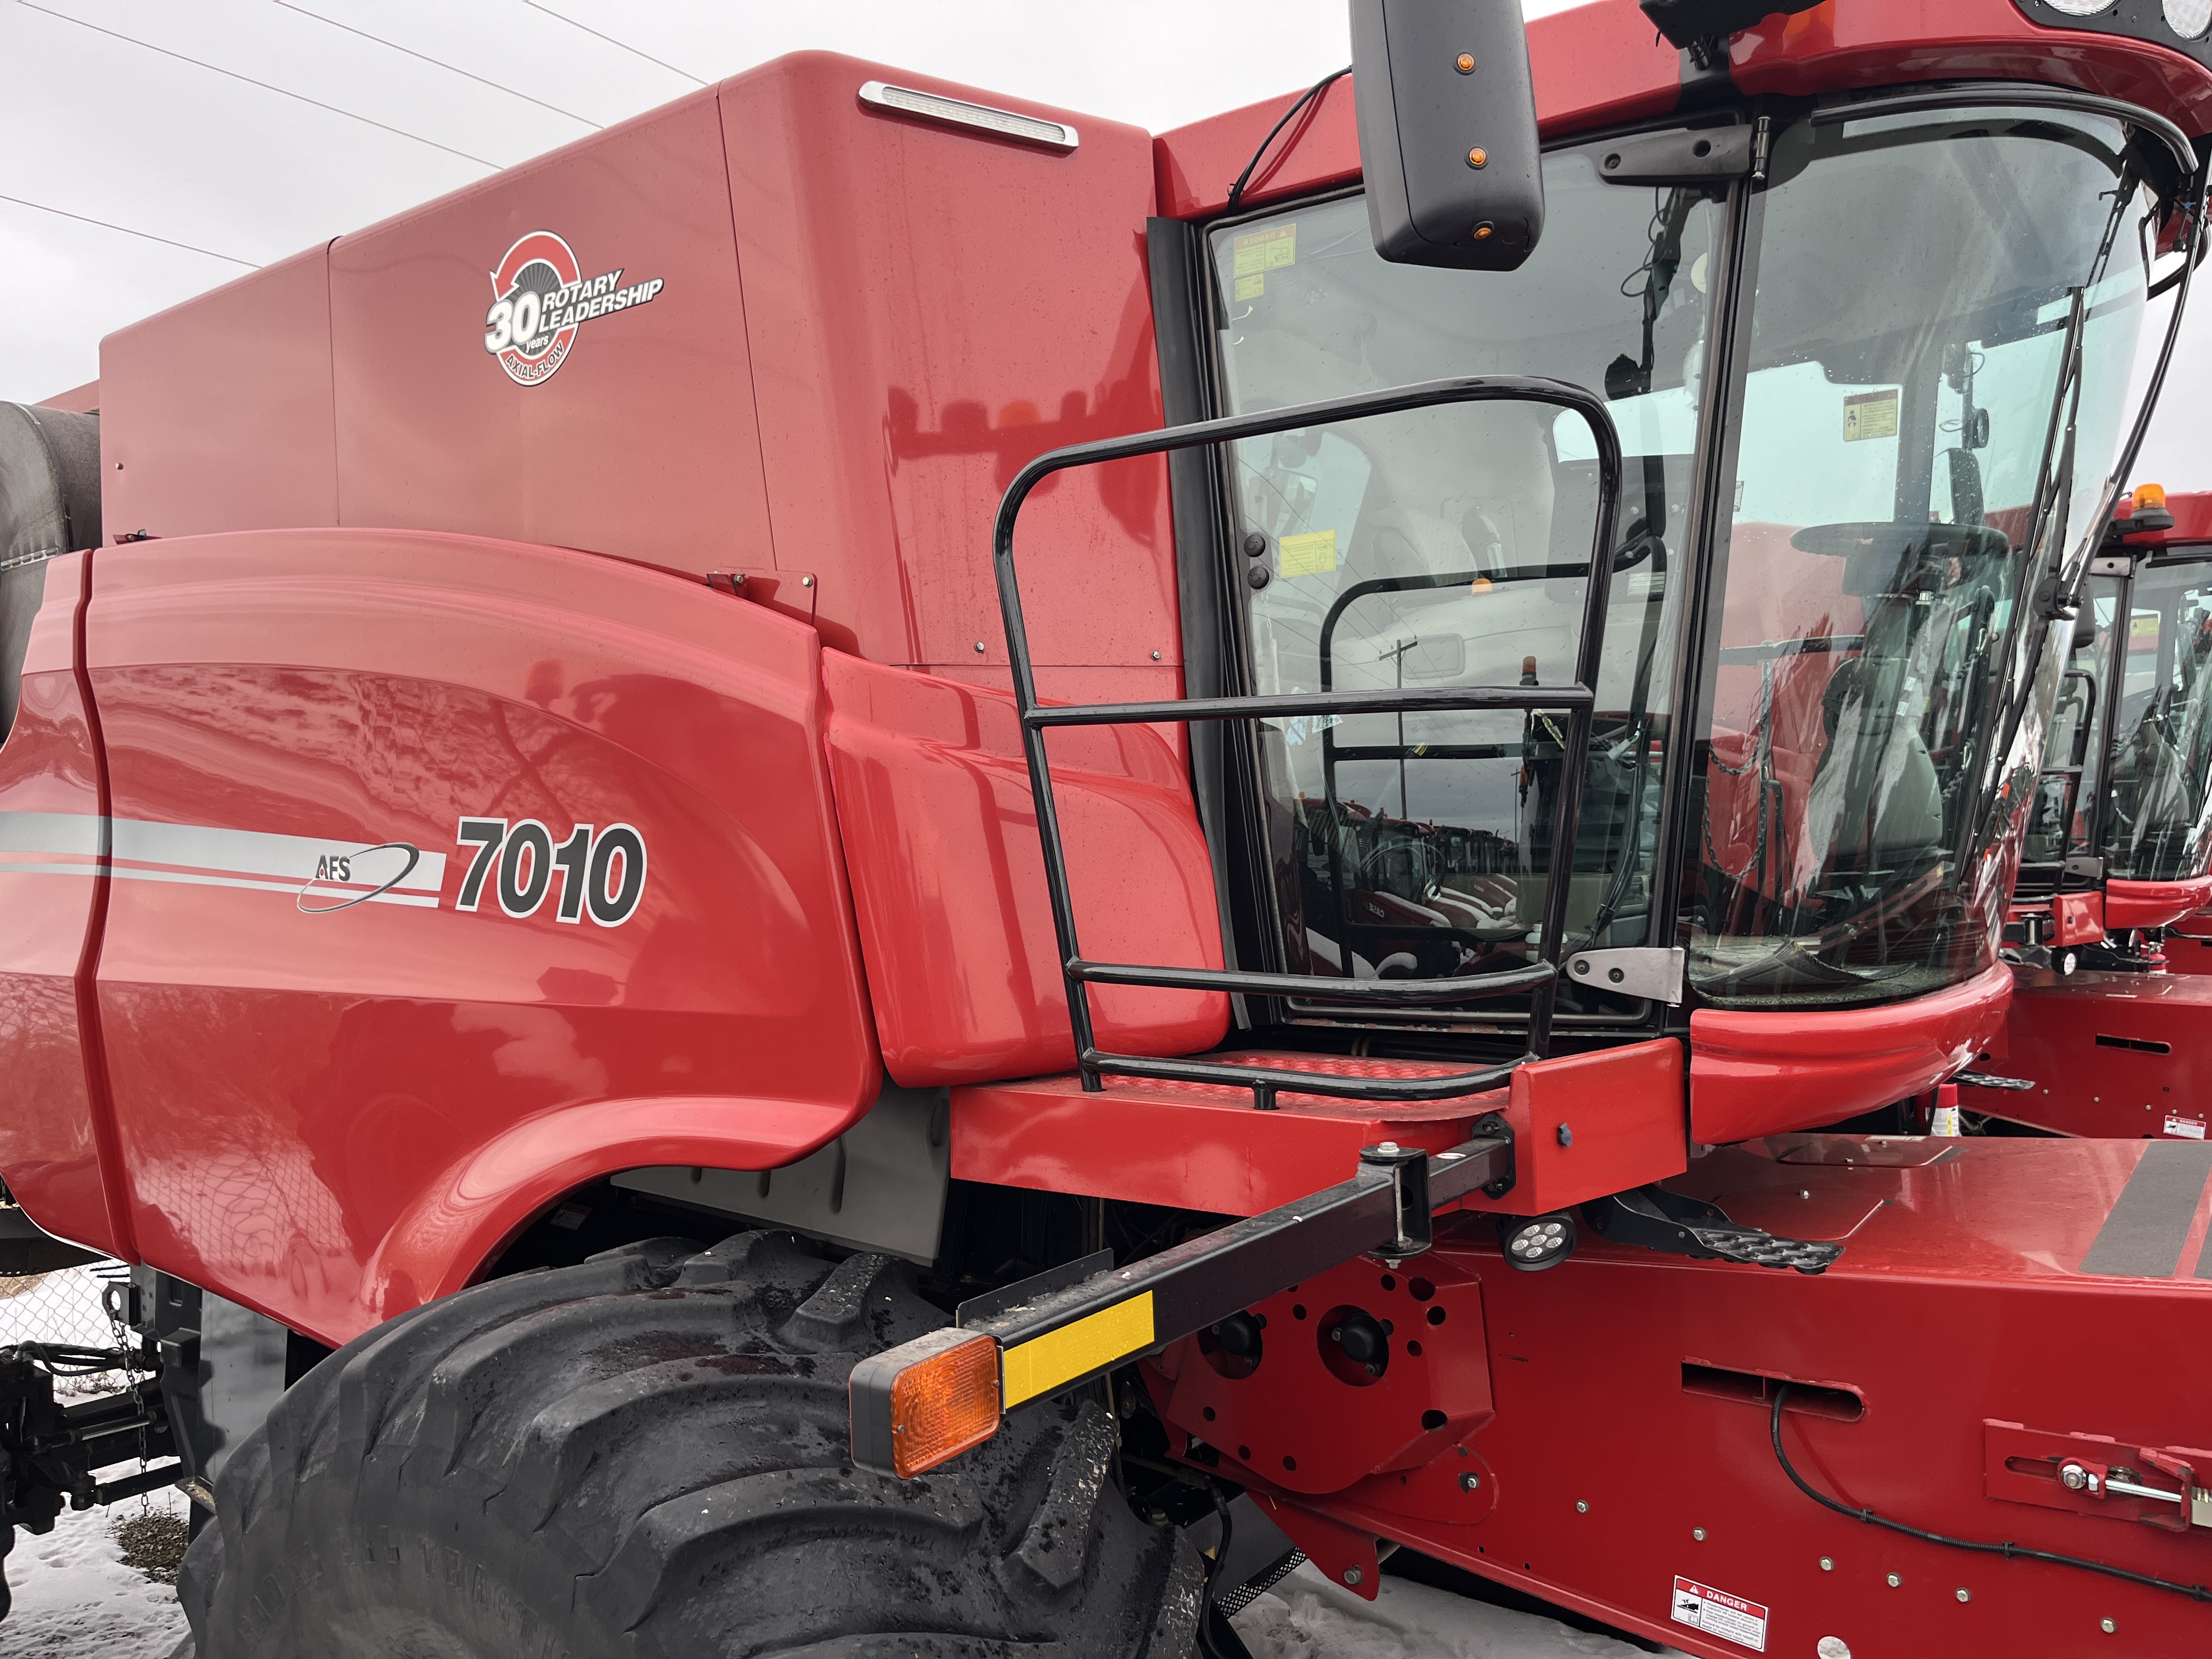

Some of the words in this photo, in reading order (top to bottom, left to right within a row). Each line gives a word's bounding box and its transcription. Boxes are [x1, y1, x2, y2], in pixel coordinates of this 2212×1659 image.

[538, 278, 664, 333] LEADERSHIP
[541, 269, 623, 313] ROTARY
[485, 291, 541, 353] 30
[505, 340, 564, 379] AXIAL-FLOW
[525, 335, 549, 353] years
[315, 854, 351, 882] AFS
[455, 816, 647, 927] 7010
[1706, 1590, 1747, 1612] DANGER
